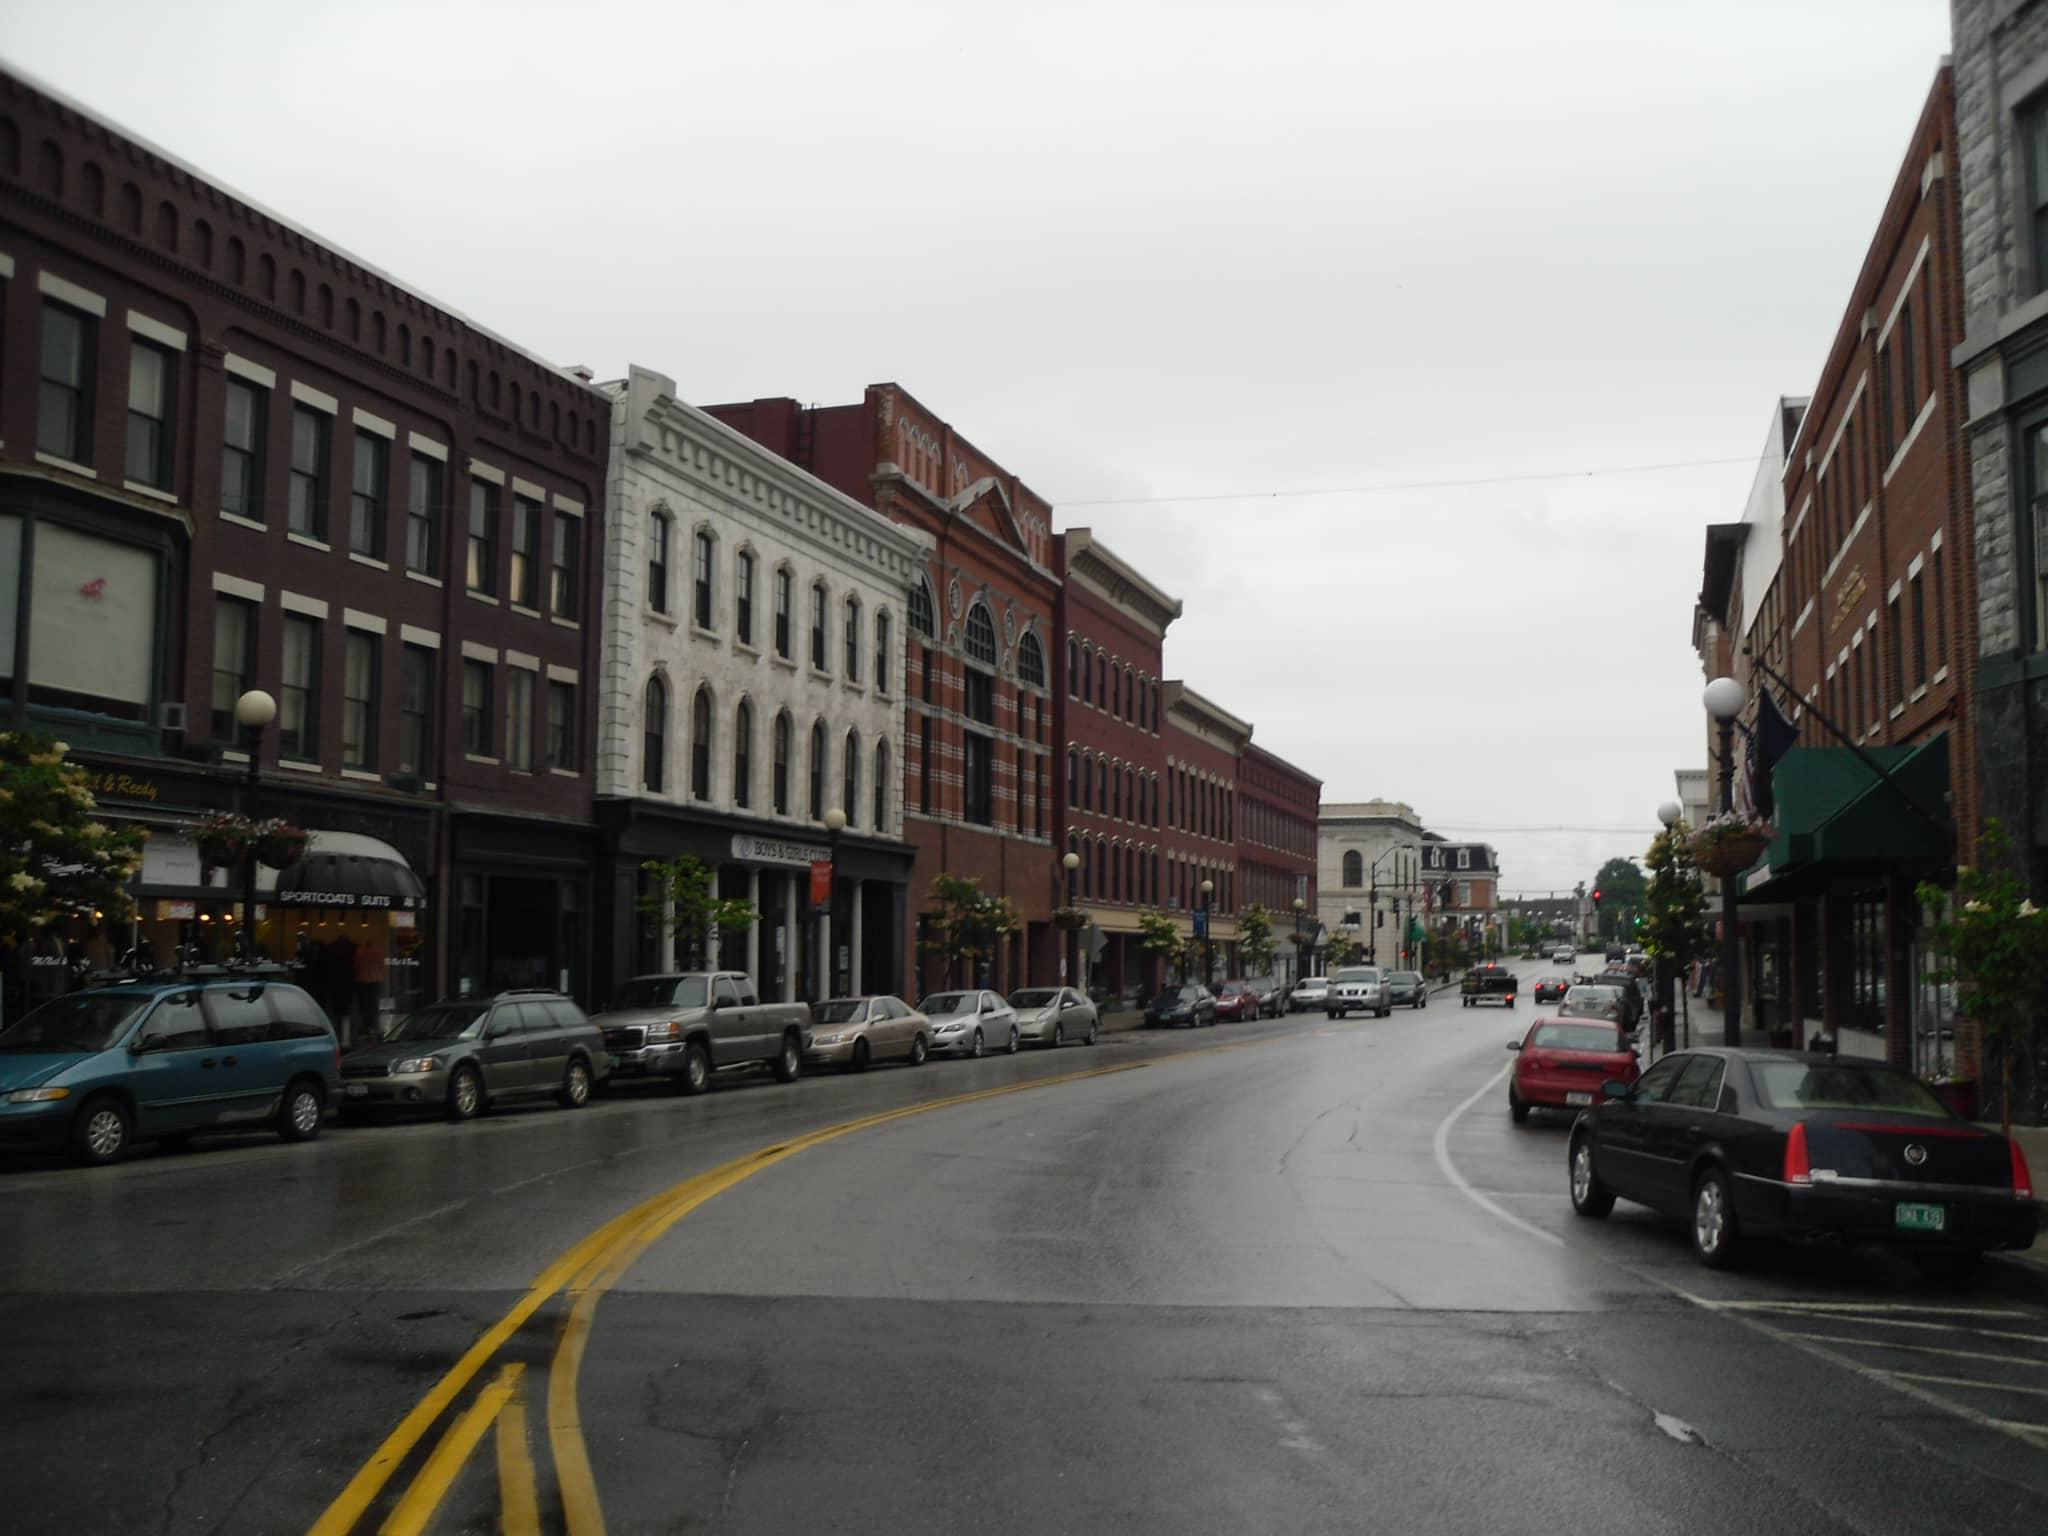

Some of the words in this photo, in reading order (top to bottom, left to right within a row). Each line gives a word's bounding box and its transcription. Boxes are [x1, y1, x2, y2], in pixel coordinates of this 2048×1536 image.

[754, 841, 777, 857] BOYS
[280, 890, 355, 905] SPORTCOATS
[361, 895, 391, 907] SUITS
